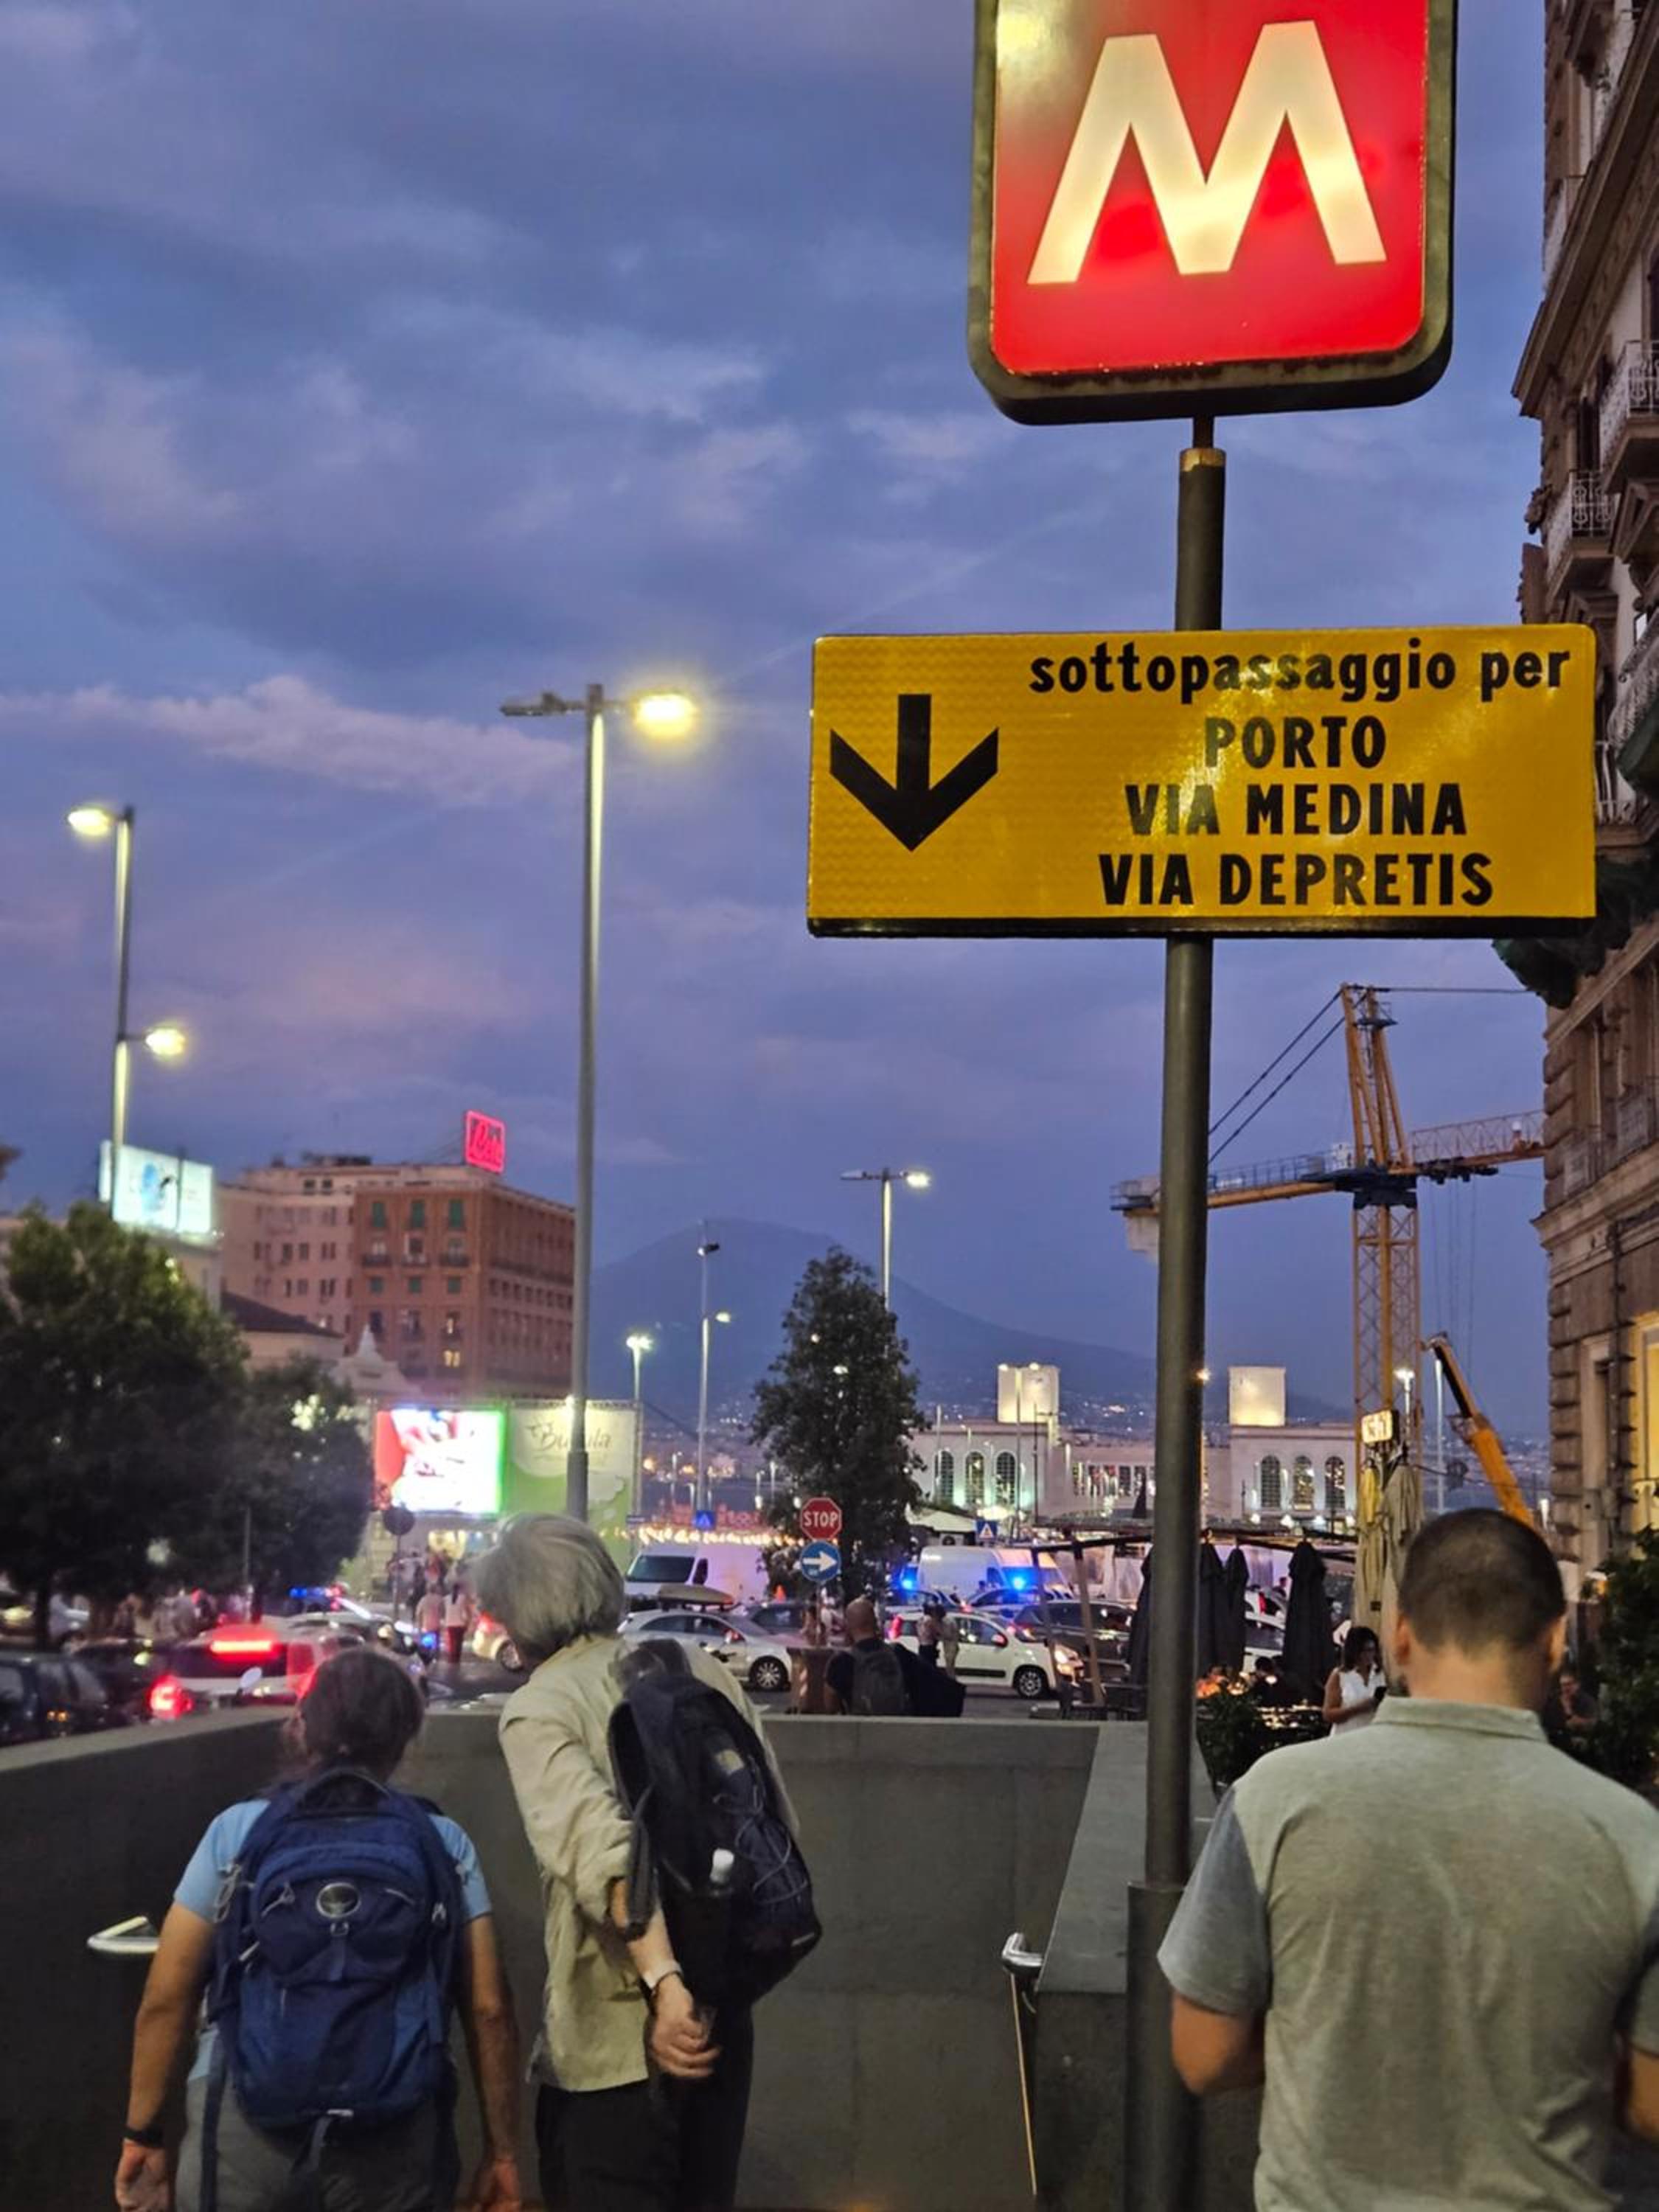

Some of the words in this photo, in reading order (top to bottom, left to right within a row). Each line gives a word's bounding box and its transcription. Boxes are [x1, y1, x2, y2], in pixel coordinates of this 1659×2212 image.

[1028, 21, 1387, 285] M
[1029, 637, 1455, 704] sottopassaggio
[1481, 650, 1571, 702] per
[1205, 716, 1386, 769] PORTO
[1125, 784, 1220, 835] VIA
[1246, 783, 1467, 835] MEDINA
[1099, 854, 1194, 906] VIA
[1220, 852, 1493, 906] DEPRETIS
[804, 1511, 838, 1527] STOP
